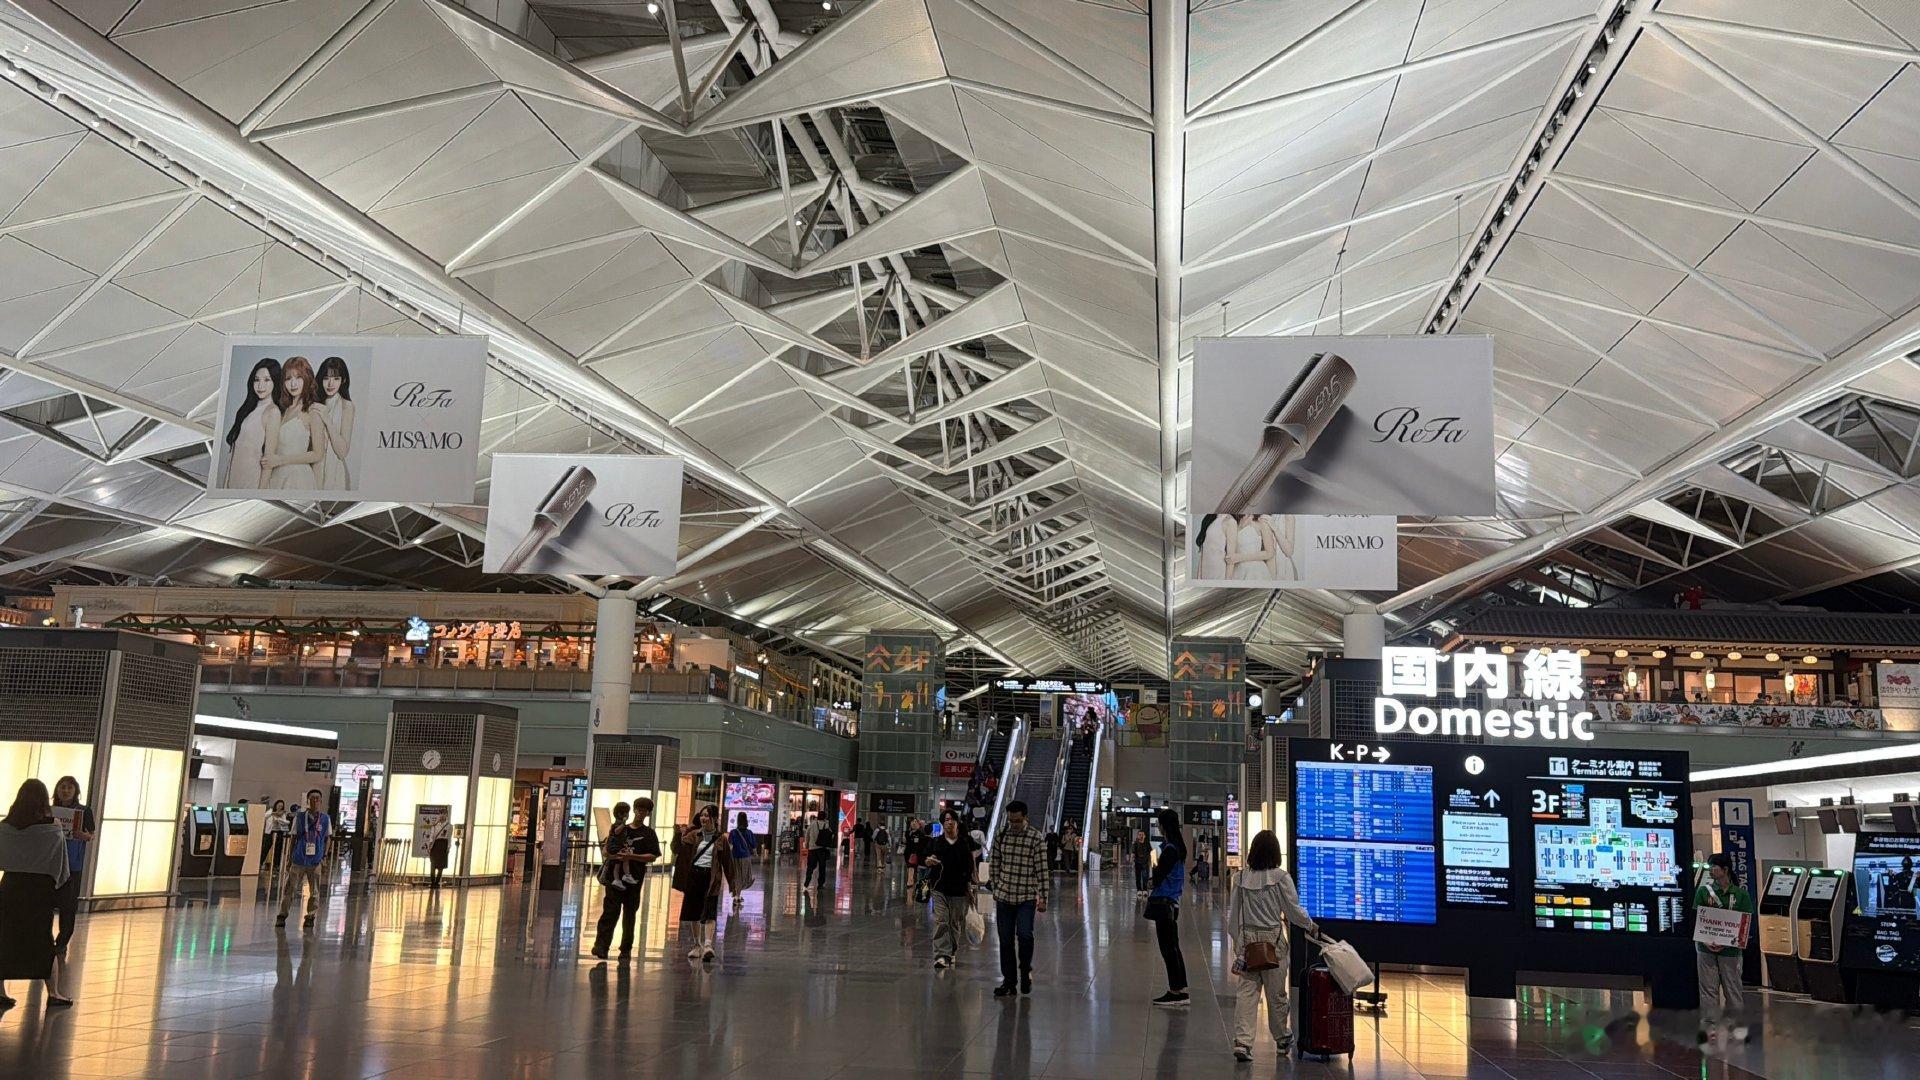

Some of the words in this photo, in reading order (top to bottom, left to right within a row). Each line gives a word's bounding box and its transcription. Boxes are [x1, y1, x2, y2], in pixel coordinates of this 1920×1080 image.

[389, 381, 456, 408] ReFa
[1369, 406, 1469, 444] ReFa
[377, 430, 463, 450] MISAMO
[601, 502, 663, 528] ReFa
[1316, 534, 1384, 551] MISAMO
[1381, 646, 1584, 701] 国内線
[1374, 697, 1595, 741] Domestic
[1329, 743, 1369, 762] K-P
[1550, 760, 1566, 772] T1
[1571, 759, 1635, 770] ターミナル案内
[1571, 767, 1606, 776] Terminal
[1608, 768, 1632, 777] Guide
[1531, 789, 1560, 813] 3F
[1732, 807, 1739, 821] 1
[1737, 851, 1747, 871] BAG
[1700, 917, 1722, 926] THANK
